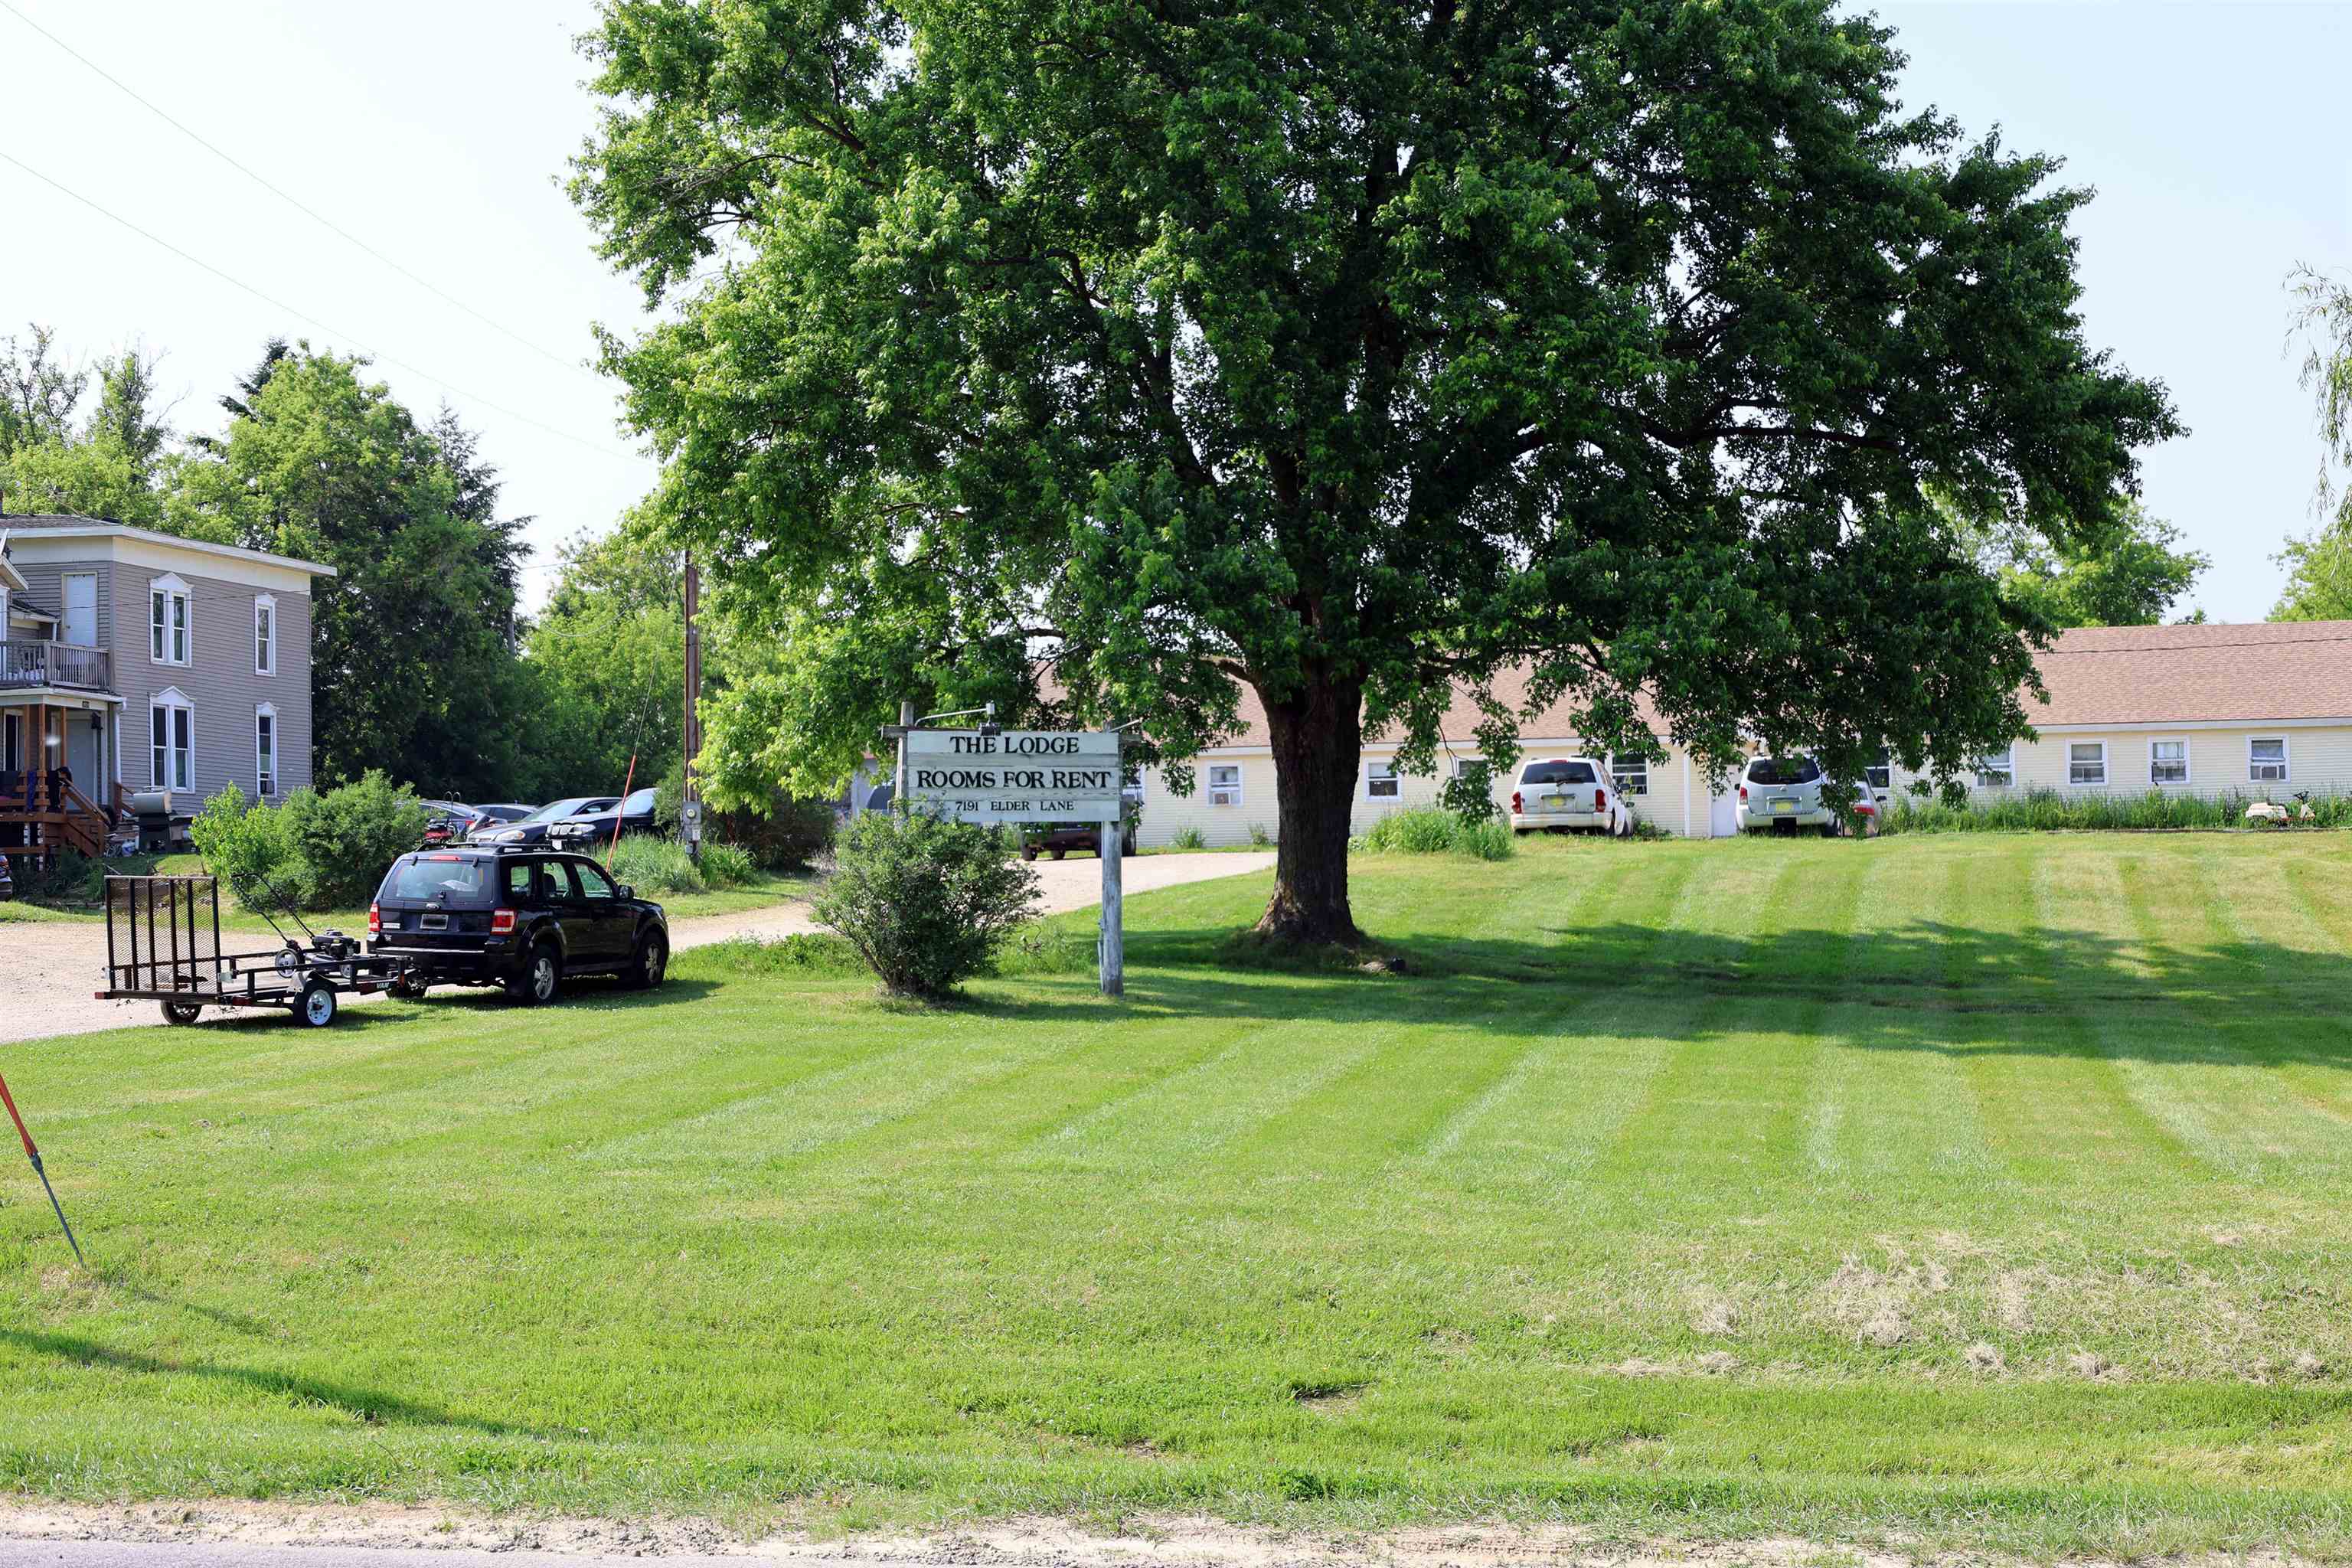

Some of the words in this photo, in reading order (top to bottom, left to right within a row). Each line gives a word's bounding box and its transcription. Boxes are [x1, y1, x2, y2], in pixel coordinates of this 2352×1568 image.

[949, 737, 997, 753] THE
[1004, 737, 1080, 753] LODGE
[917, 770, 996, 788] ROOMS
[1004, 771, 1046, 788] FOR
[1052, 769, 1112, 789] RENT
[956, 801, 979, 812] 7191
[991, 801, 1030, 812] ELDER
[1040, 801, 1074, 812] LANE
